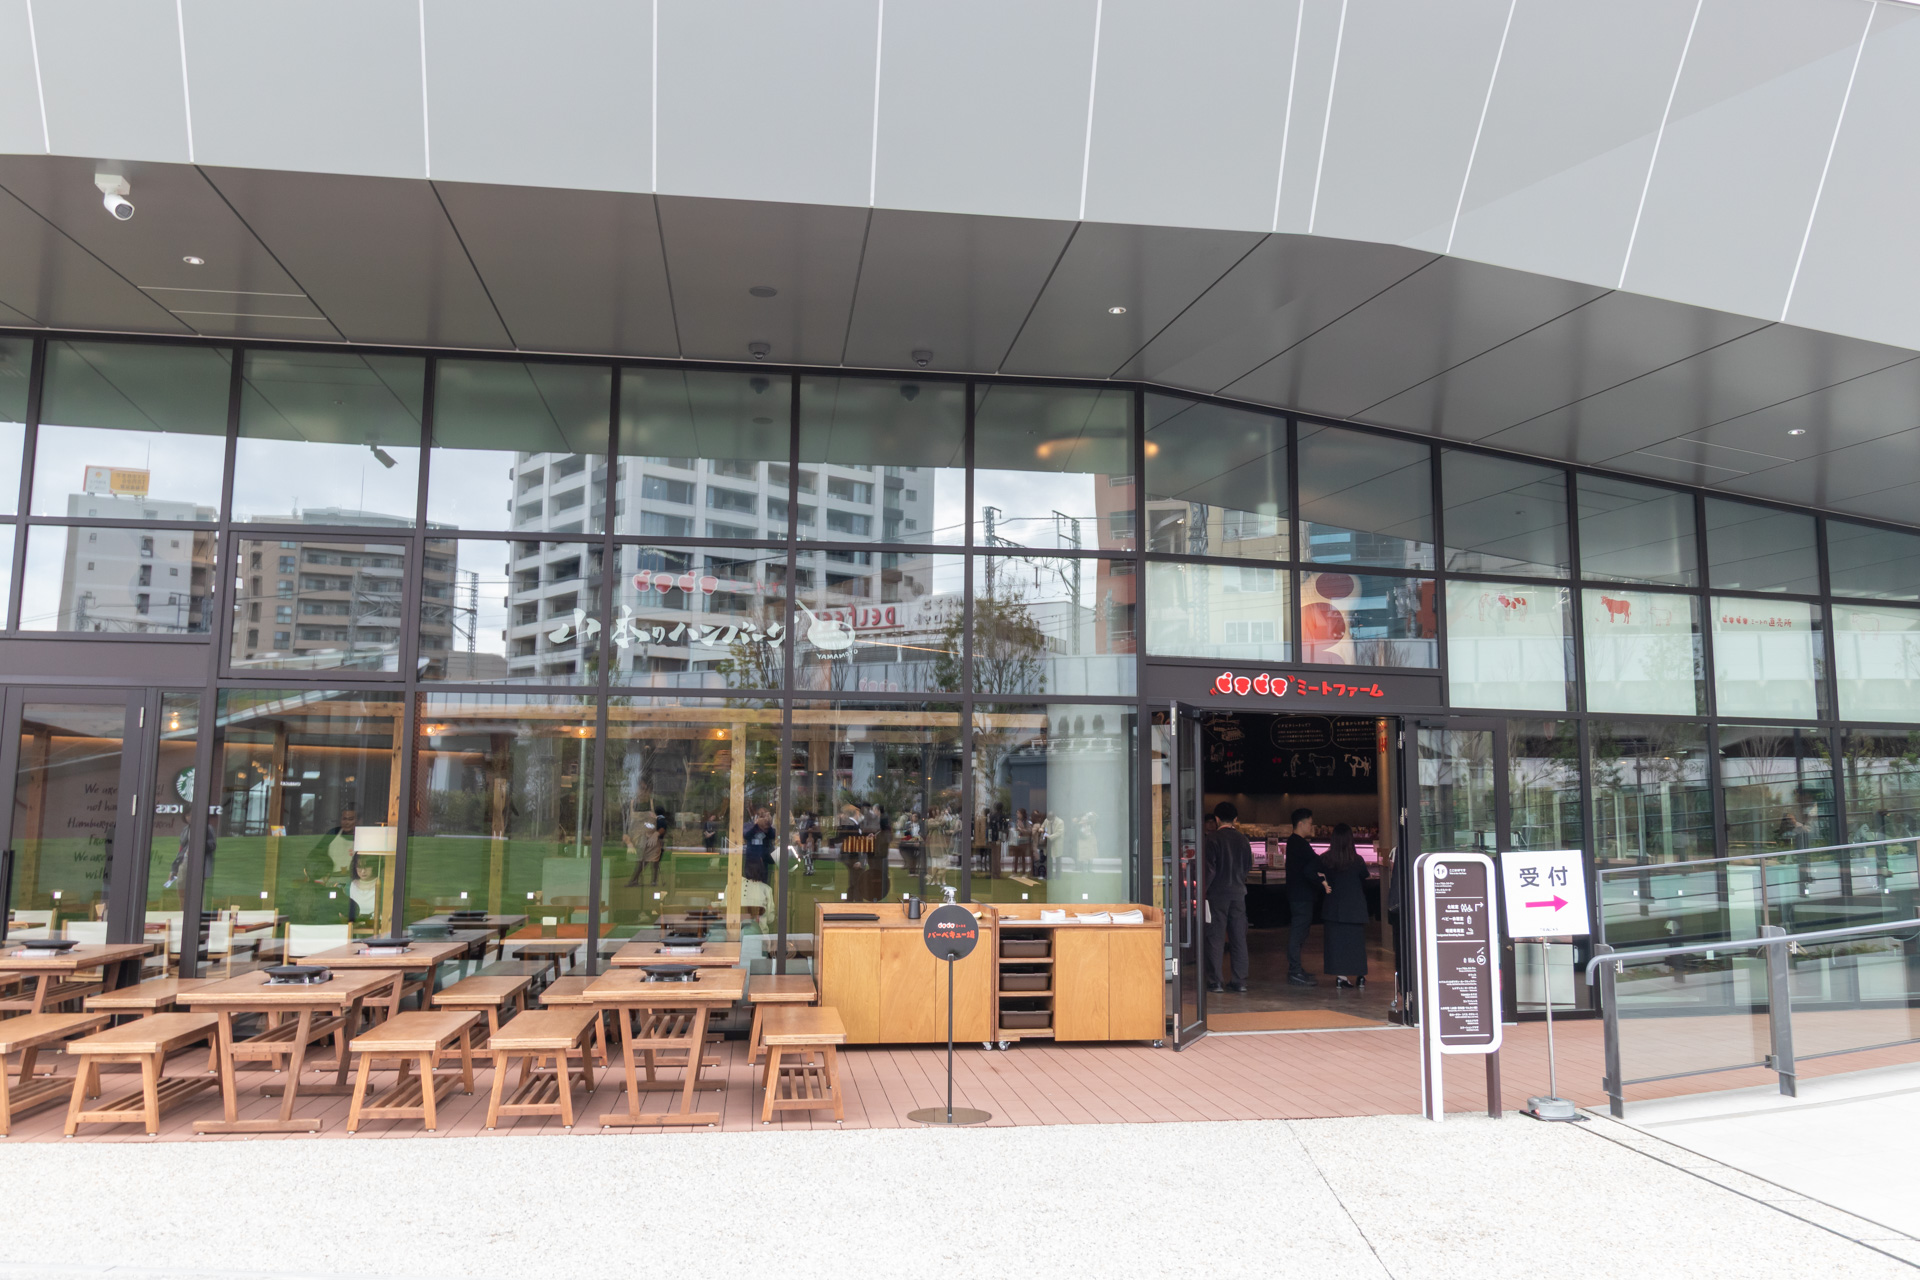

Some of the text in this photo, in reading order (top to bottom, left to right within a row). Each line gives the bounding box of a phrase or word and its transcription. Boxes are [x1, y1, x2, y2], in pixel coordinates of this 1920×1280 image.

[816, 649, 858, 660] YAMAMOTO
[1297, 679, 1384, 698] ミートファーム
[85, 783, 118, 794] We are
[87, 800, 102, 811] not
[74, 851, 89, 862] We
[1519, 865, 1568, 888] 受付
[928, 930, 975, 939] バーベキュー場
